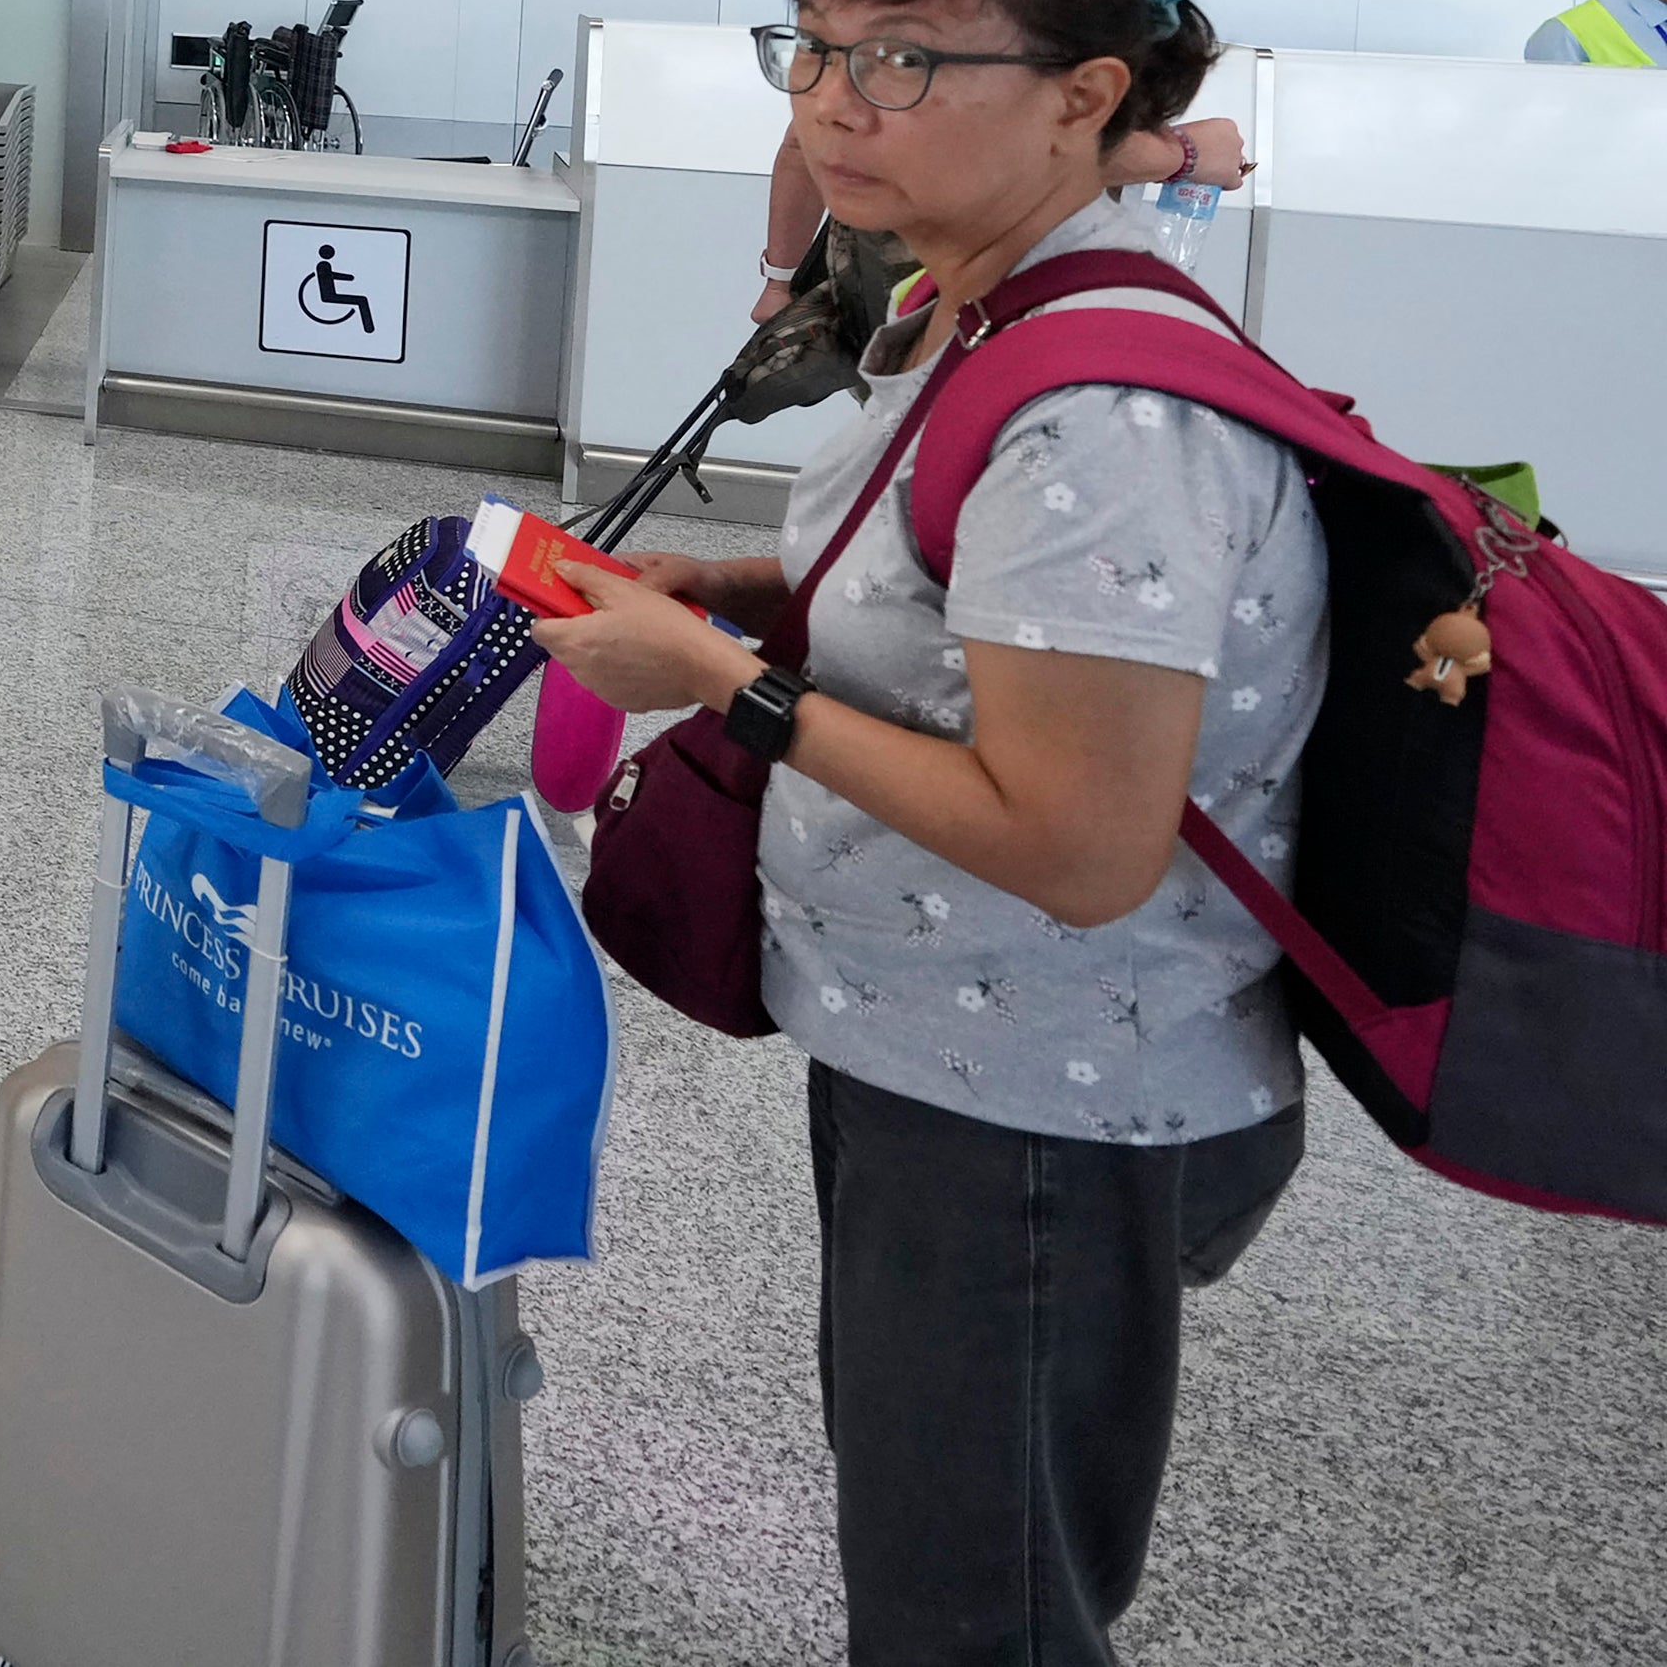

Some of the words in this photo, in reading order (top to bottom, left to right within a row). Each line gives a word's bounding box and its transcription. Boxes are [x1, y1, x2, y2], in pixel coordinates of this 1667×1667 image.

[134, 859, 241, 981] PRINCESS
[279, 968, 424, 1061] RUISES
[171, 951, 211, 996] come
[217, 983, 241, 1015] ba
